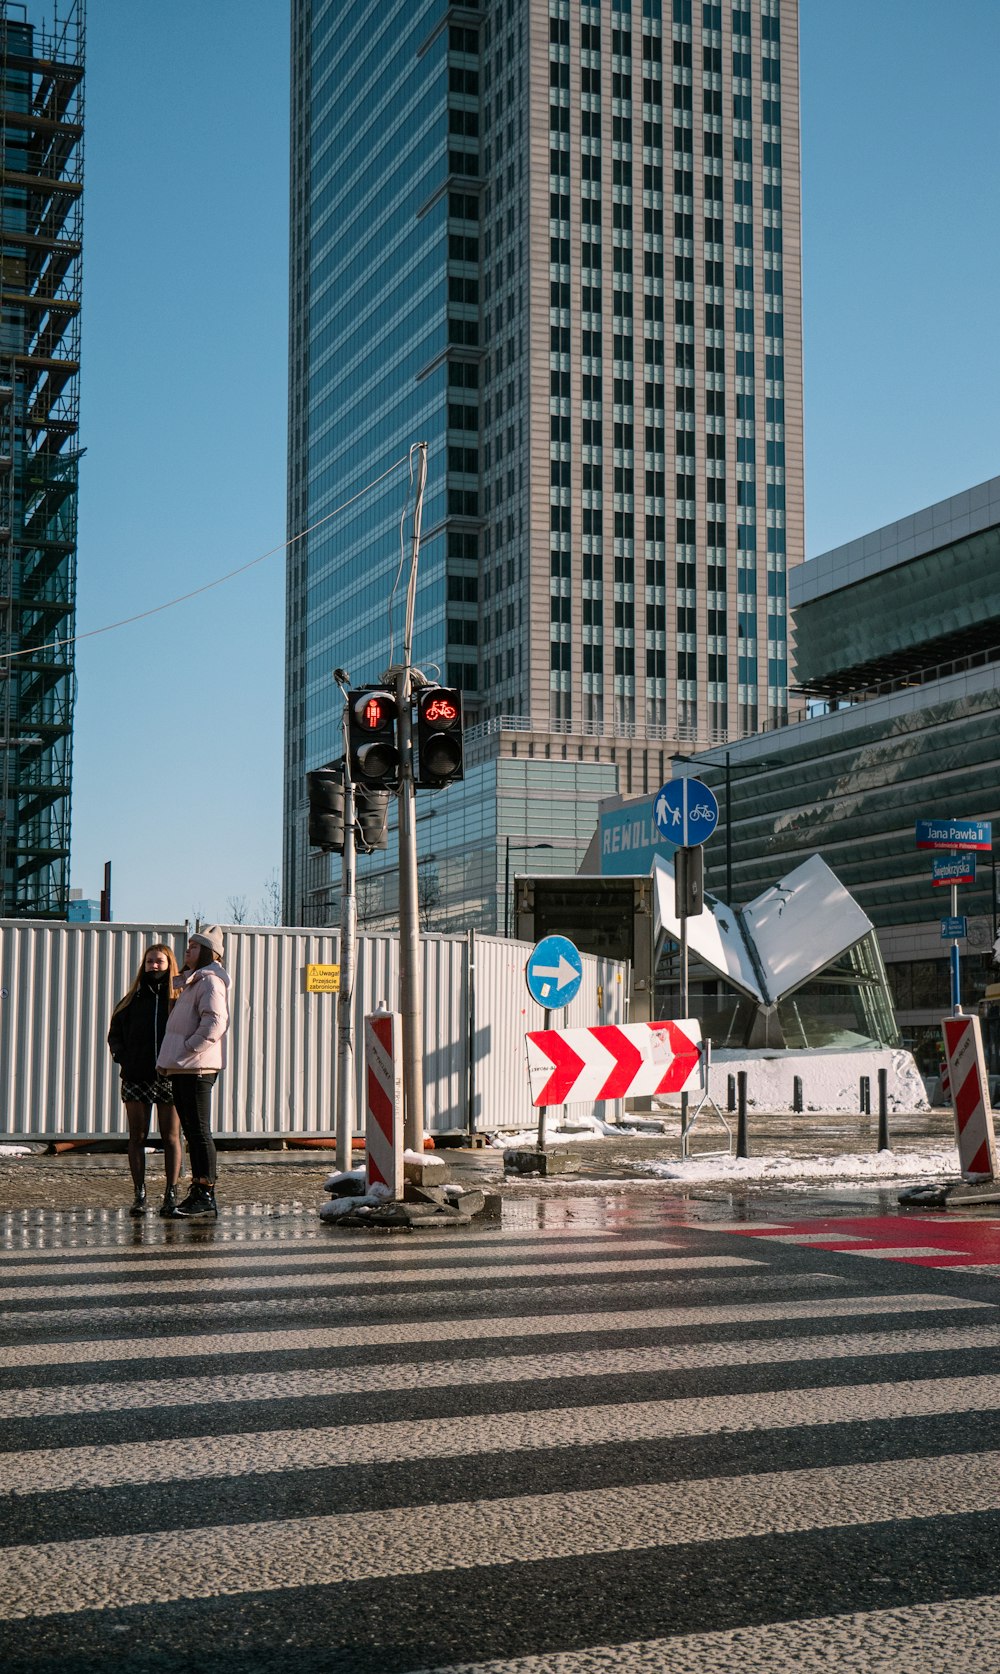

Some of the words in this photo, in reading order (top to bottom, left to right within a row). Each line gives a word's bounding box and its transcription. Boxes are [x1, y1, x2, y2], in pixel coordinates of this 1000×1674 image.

[603, 818, 667, 855] REWOLU
[927, 828, 948, 839] Jana
[949, 828, 977, 840] Pawła
[978, 829, 983, 840] II
[319, 970, 340, 978] Uwaga!
